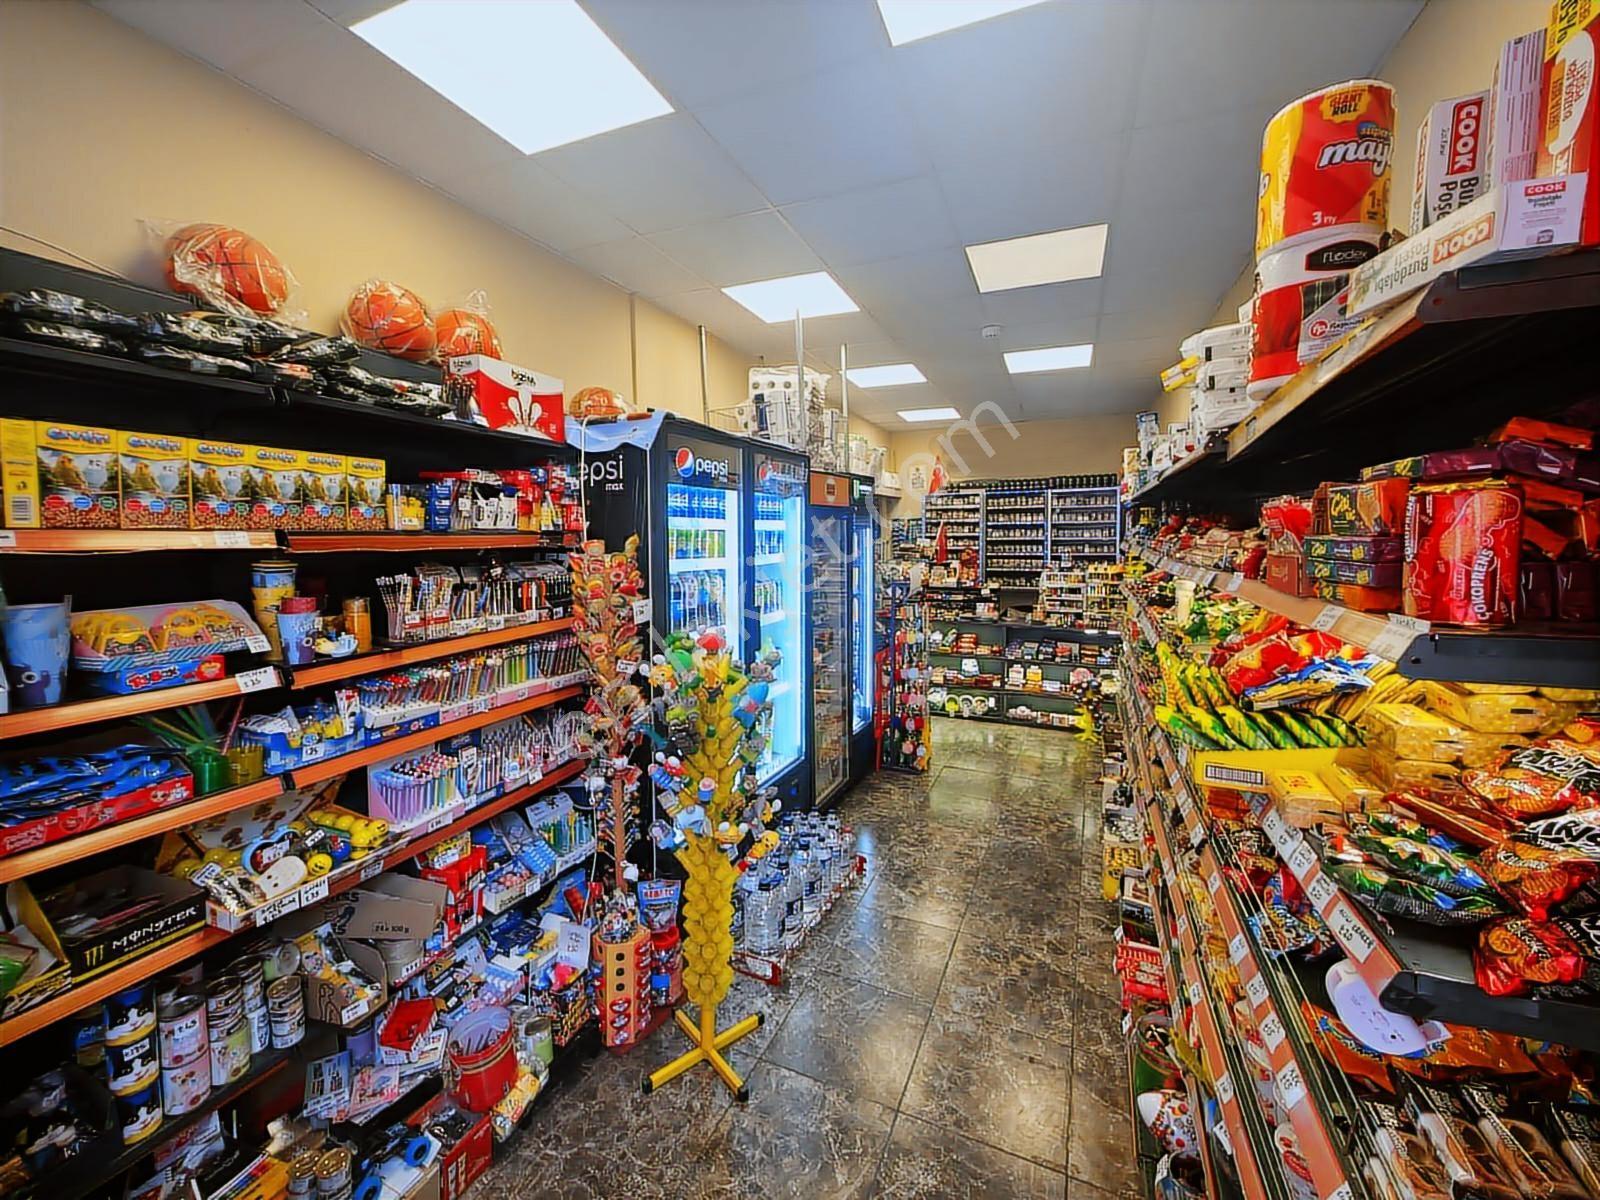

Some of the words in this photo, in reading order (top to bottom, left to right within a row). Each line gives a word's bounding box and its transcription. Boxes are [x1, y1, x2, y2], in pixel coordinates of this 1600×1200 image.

[1329, 93, 1363, 107] GIANT
[1332, 102, 1359, 116] ROLL
[1454, 104, 1479, 172] COOK
[1526, 183, 1564, 194] COOK
[1312, 211, 1322, 226] 3
[1436, 221, 1491, 261] COOK
[695, 457, 728, 478] pepsi
